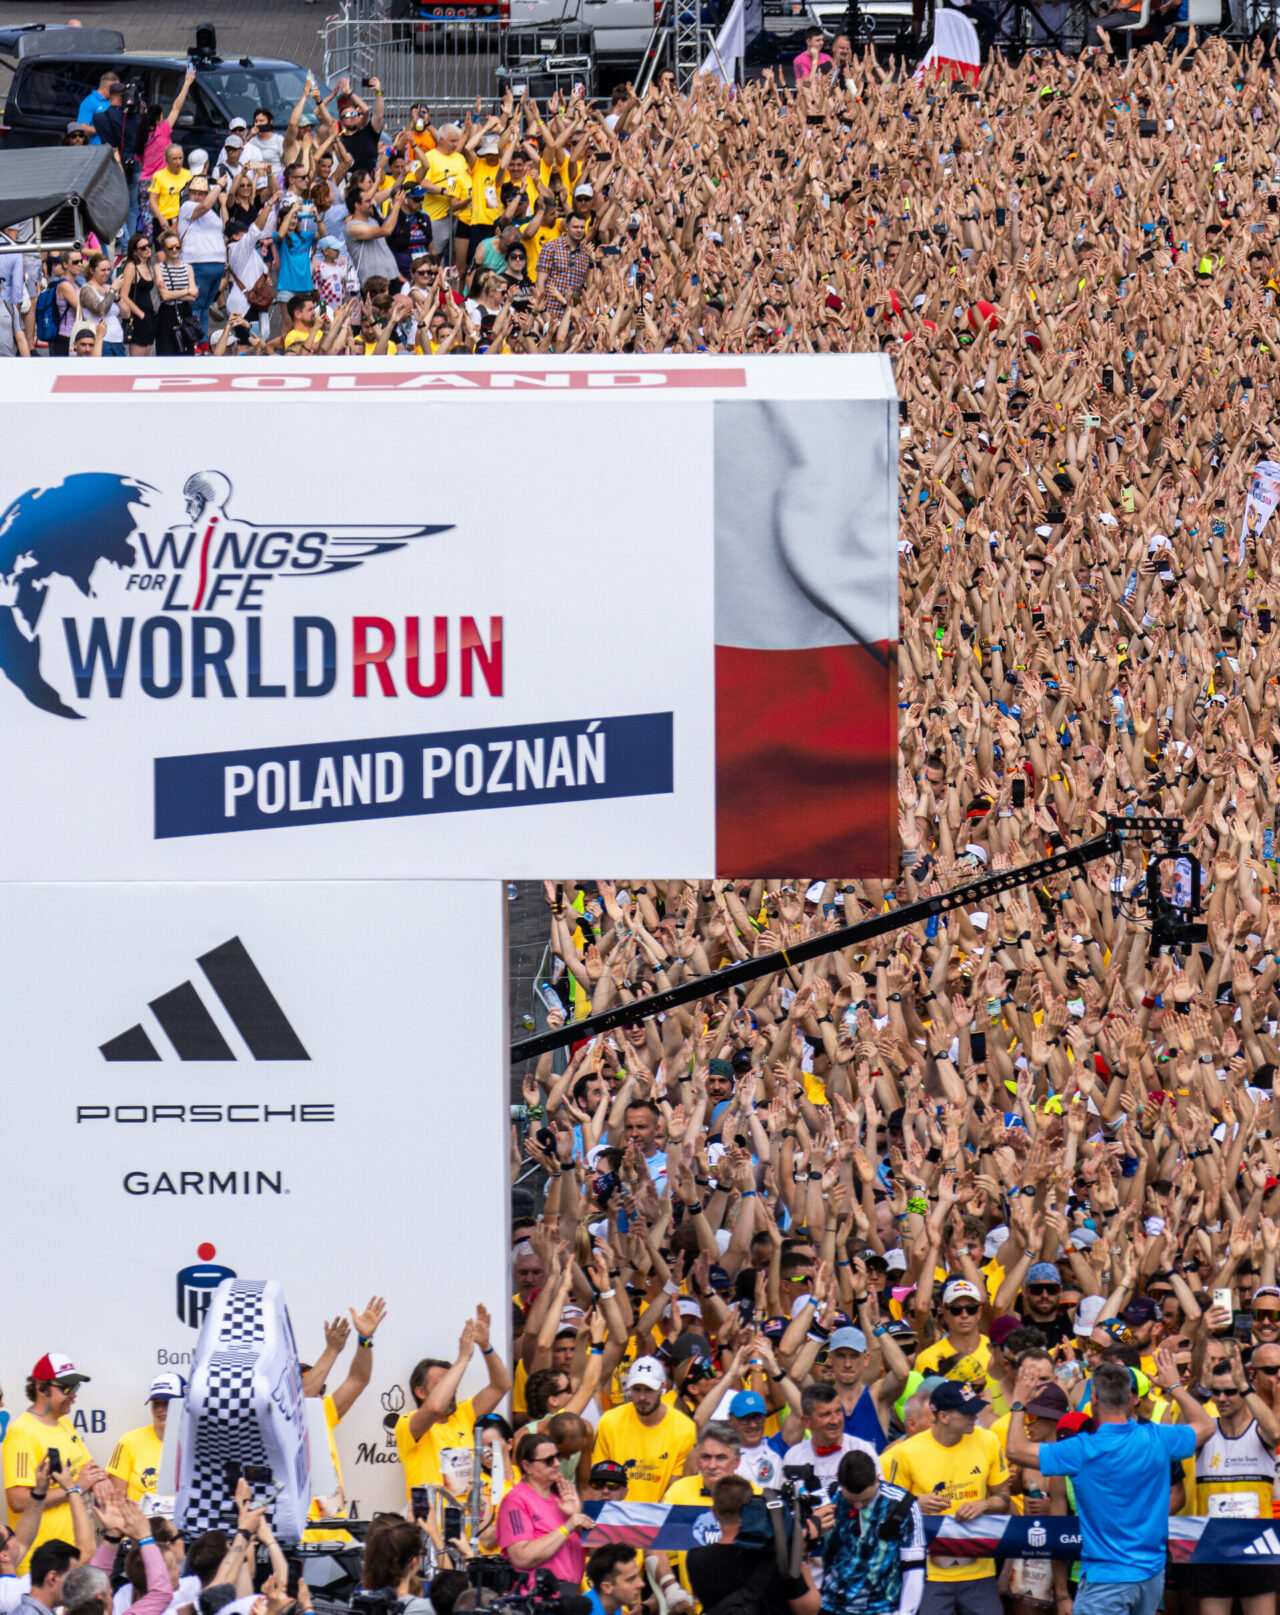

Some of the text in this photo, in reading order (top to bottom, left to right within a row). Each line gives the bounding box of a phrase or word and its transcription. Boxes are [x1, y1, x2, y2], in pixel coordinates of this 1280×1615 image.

[132, 372, 668, 390] POLAND
[126, 574, 166, 591] FOR
[62, 615, 504, 699] WORLD RUN
[224, 721, 607, 817] POLAND POZNAŃ
[77, 1104, 335, 1123] PORSCHE
[123, 1171, 282, 1195] GARMIN
[963, 1490, 978, 1499] RUN
